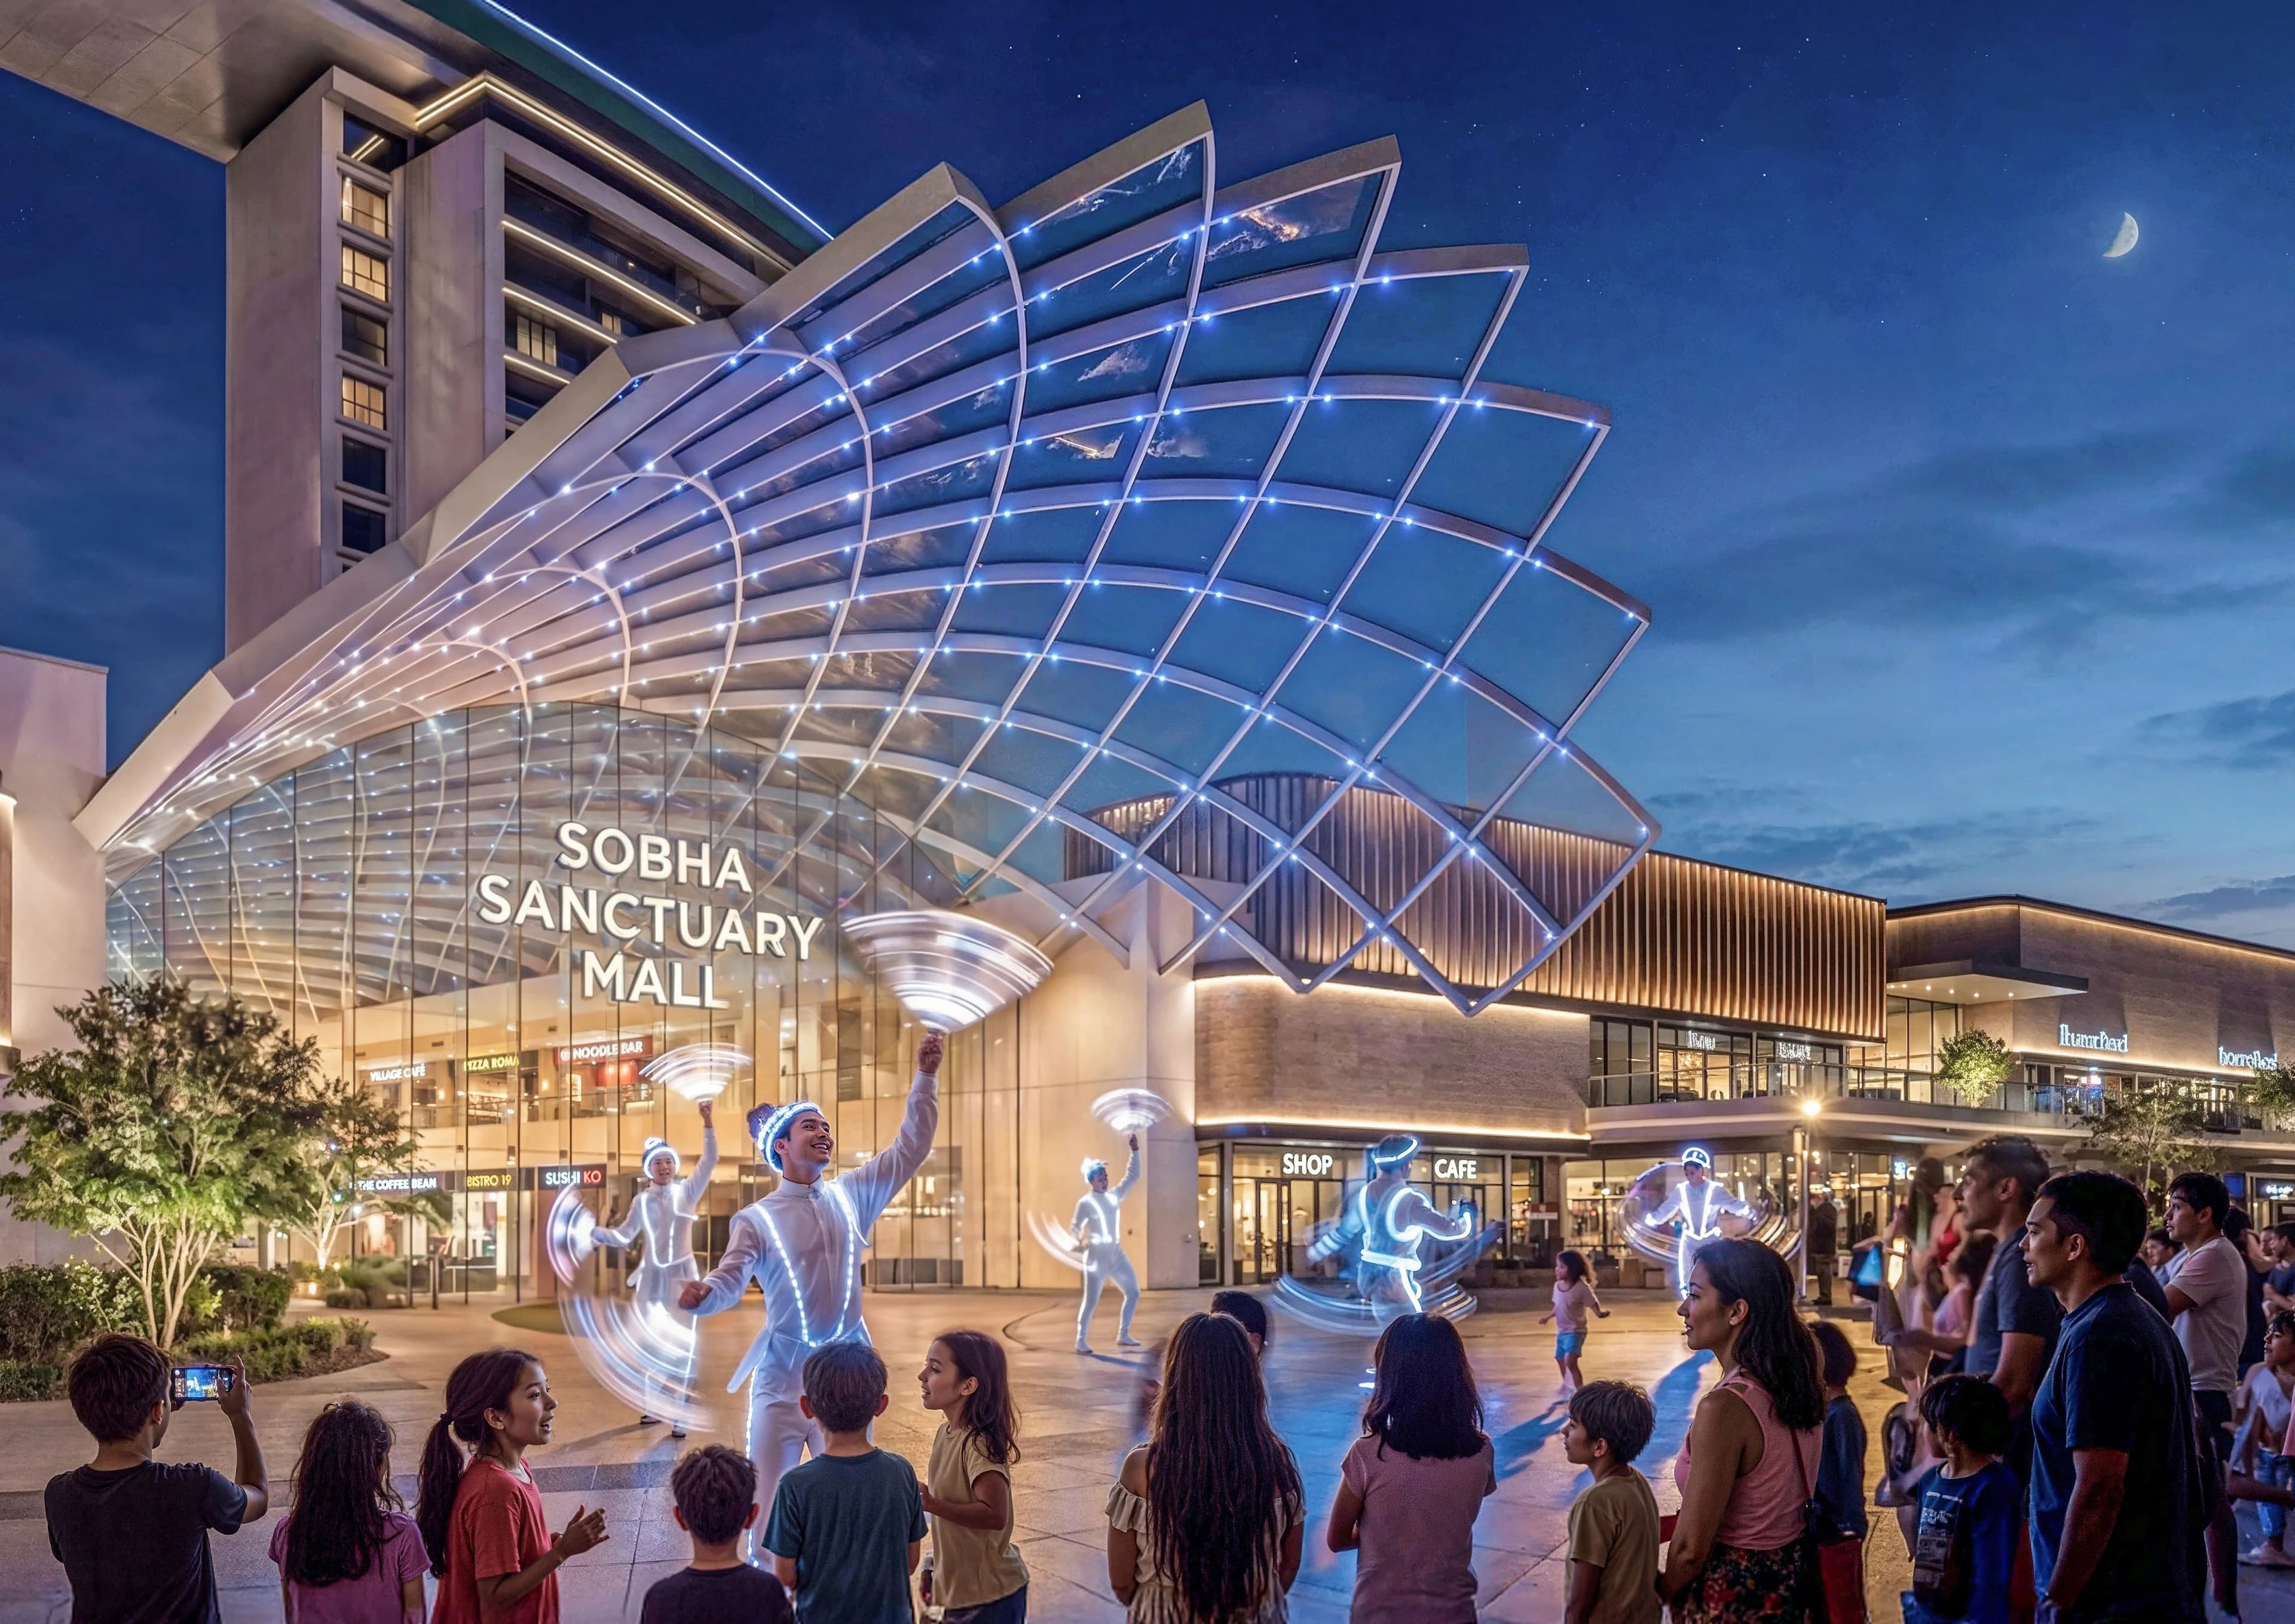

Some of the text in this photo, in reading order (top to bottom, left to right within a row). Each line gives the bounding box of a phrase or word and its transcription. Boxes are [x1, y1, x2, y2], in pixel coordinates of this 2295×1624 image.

[558, 821, 752, 894] SOBHA
[478, 874, 823, 961] SANCTUARY
[582, 949, 730, 1009] MALL
[573, 1041, 643, 1059] NOODLE BAR
[464, 1056, 519, 1072] PIZZA ROMA
[370, 1069, 402, 1082] VILLAGE
[1283, 1153, 1333, 1175] SHOP
[1434, 1159, 1477, 1179] CAFE
[358, 1177, 437, 1191] THE COFFEE BEAN
[467, 1174, 512, 1187] BISTRO 19
[546, 1170, 601, 1185] SUSHI KO
